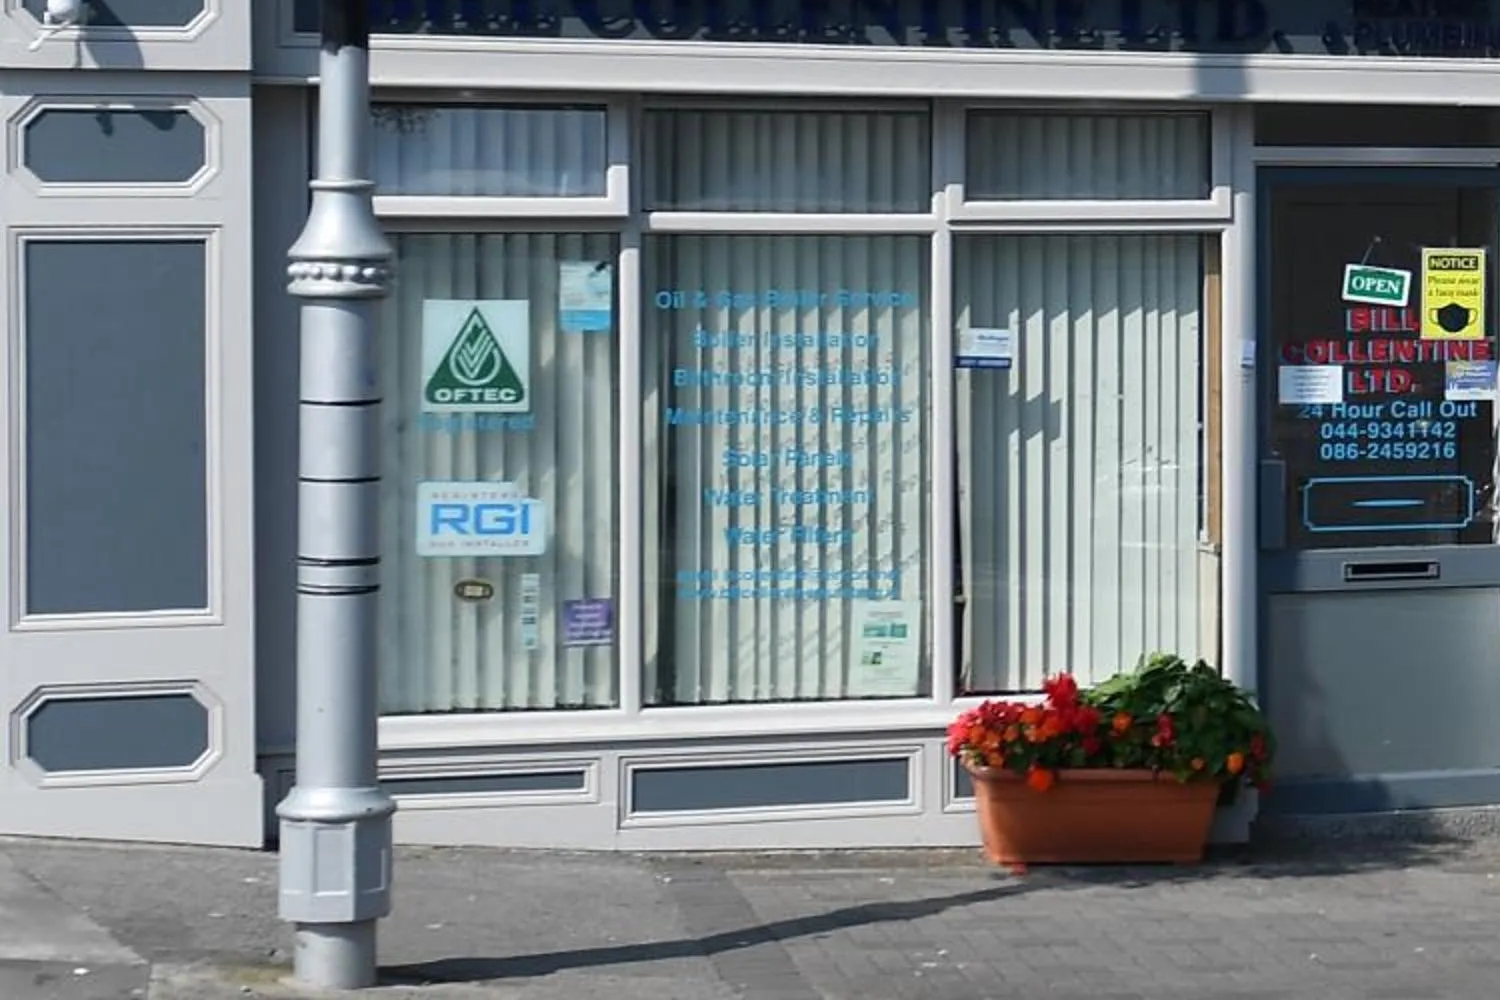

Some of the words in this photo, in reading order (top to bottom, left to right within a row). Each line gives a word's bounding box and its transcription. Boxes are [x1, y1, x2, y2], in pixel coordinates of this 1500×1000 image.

[1429, 257, 1478, 270] NOTICE
[1351, 275, 1402, 294] OPEN
[1428, 275, 1456, 285] Please
[655, 290, 685, 309] Oil
[1346, 308, 1420, 331] BILL
[763, 331, 880, 348] Installation
[1282, 339, 1492, 364] COLLENTINE
[785, 369, 903, 387] Installation
[434, 387, 517, 402] OFTEC
[831, 407, 912, 428] Repairs
[1298, 402, 1323, 418] 24
[1331, 402, 1384, 418] Hour
[1391, 401, 1431, 418] Call
[1439, 401, 1477, 417] Out
[1321, 422, 1457, 439] 044-9341142
[722, 450, 776, 467] Solar
[786, 449, 852, 467] Panels
[1320, 442, 1456, 460] 086-2459216
[703, 487, 762, 505] Water
[772, 487, 875, 505] Treatment
[430, 503, 530, 535] RGI
[724, 528, 778, 545] Water
